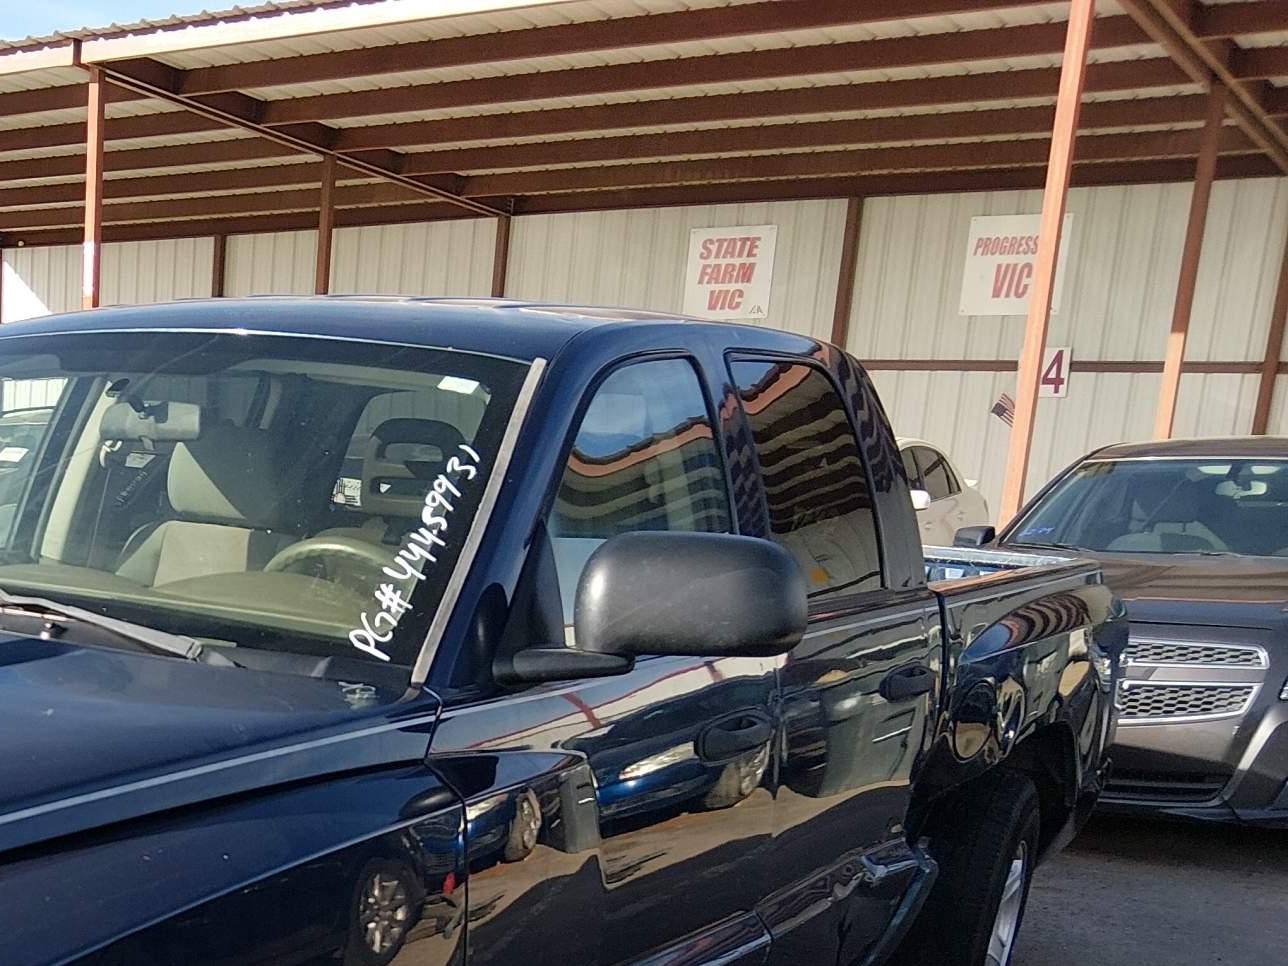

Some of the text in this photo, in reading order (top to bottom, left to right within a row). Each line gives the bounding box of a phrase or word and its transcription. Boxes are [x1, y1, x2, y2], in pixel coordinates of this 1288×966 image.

[699, 236, 761, 260] STATE
[697, 262, 756, 285] FARM
[992, 262, 1033, 299] VIC
[707, 288, 745, 311] VIC
[1041, 350, 1065, 394] 4
